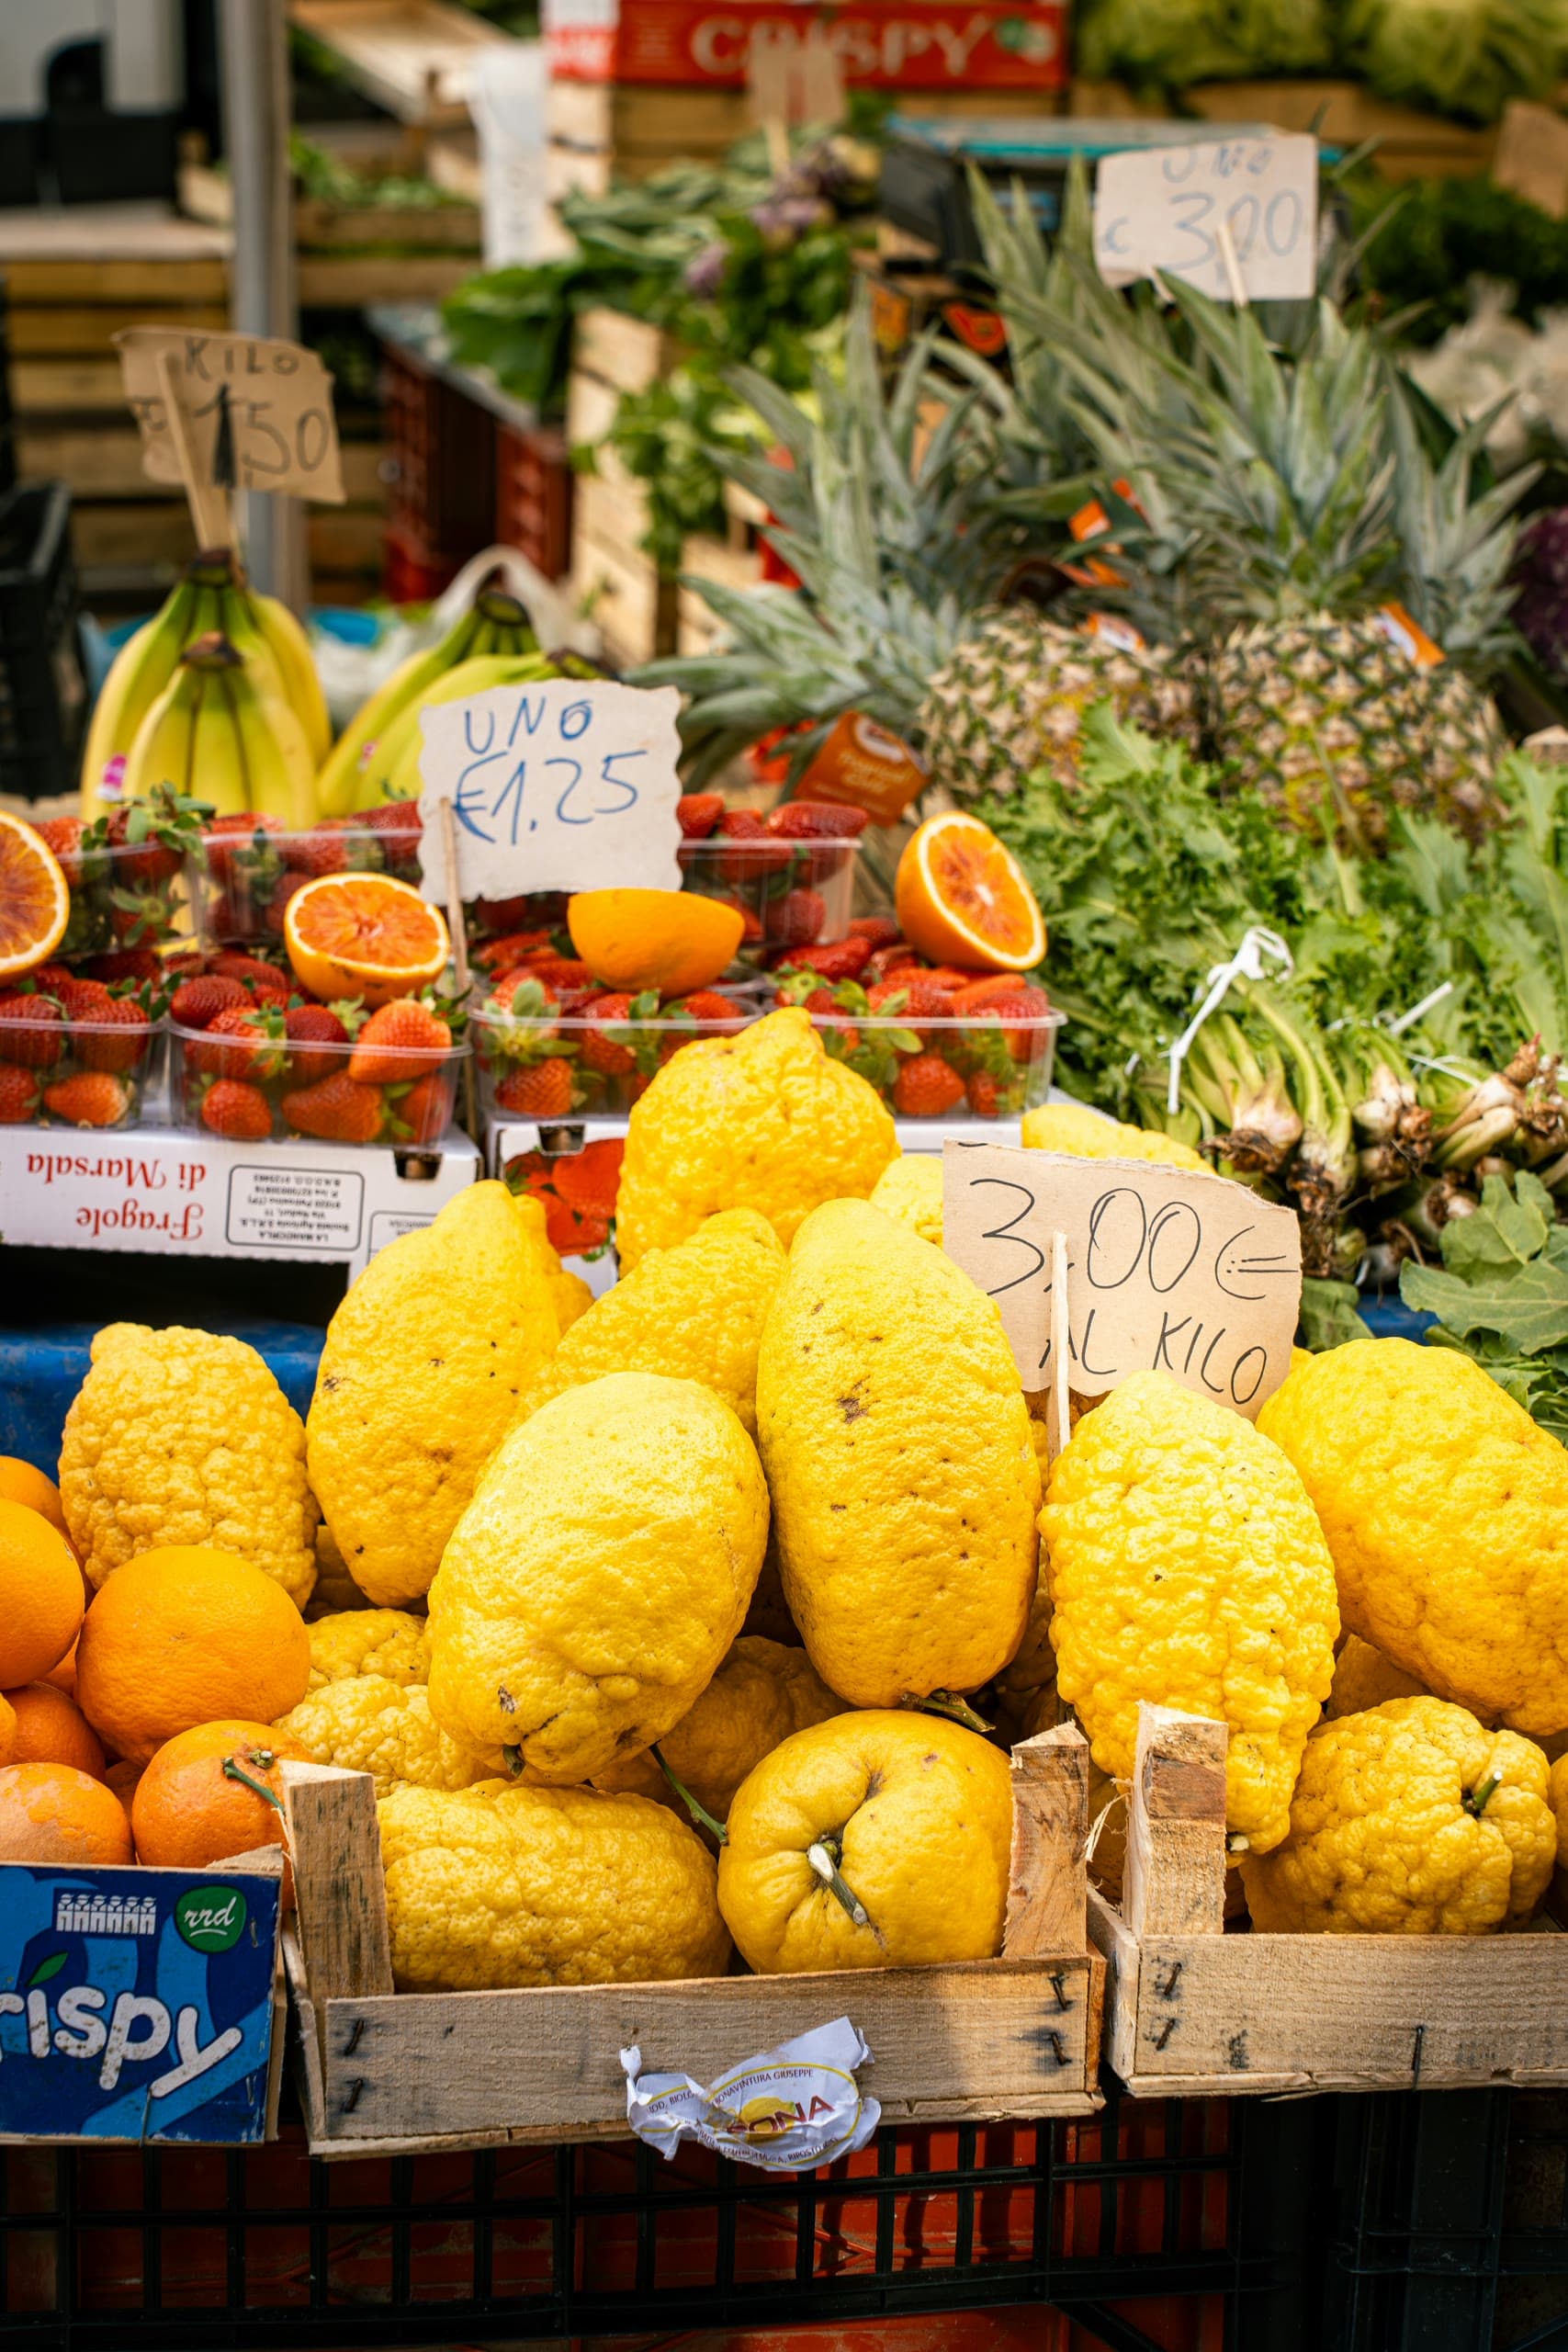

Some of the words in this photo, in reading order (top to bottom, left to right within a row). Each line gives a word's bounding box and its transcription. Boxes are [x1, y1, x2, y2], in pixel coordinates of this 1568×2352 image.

[184, 337, 299, 380] KILO
[464, 695, 594, 755] UNO
[27, 1153, 167, 1190] Marsala
[179, 1162, 207, 1192] di
[75, 1197, 205, 1241] Fragole
[1153, 1311, 1268, 1405] KILO
[773, 2068, 814, 2080] GIUSEPPE
[727, 2095, 837, 2134] ONA
